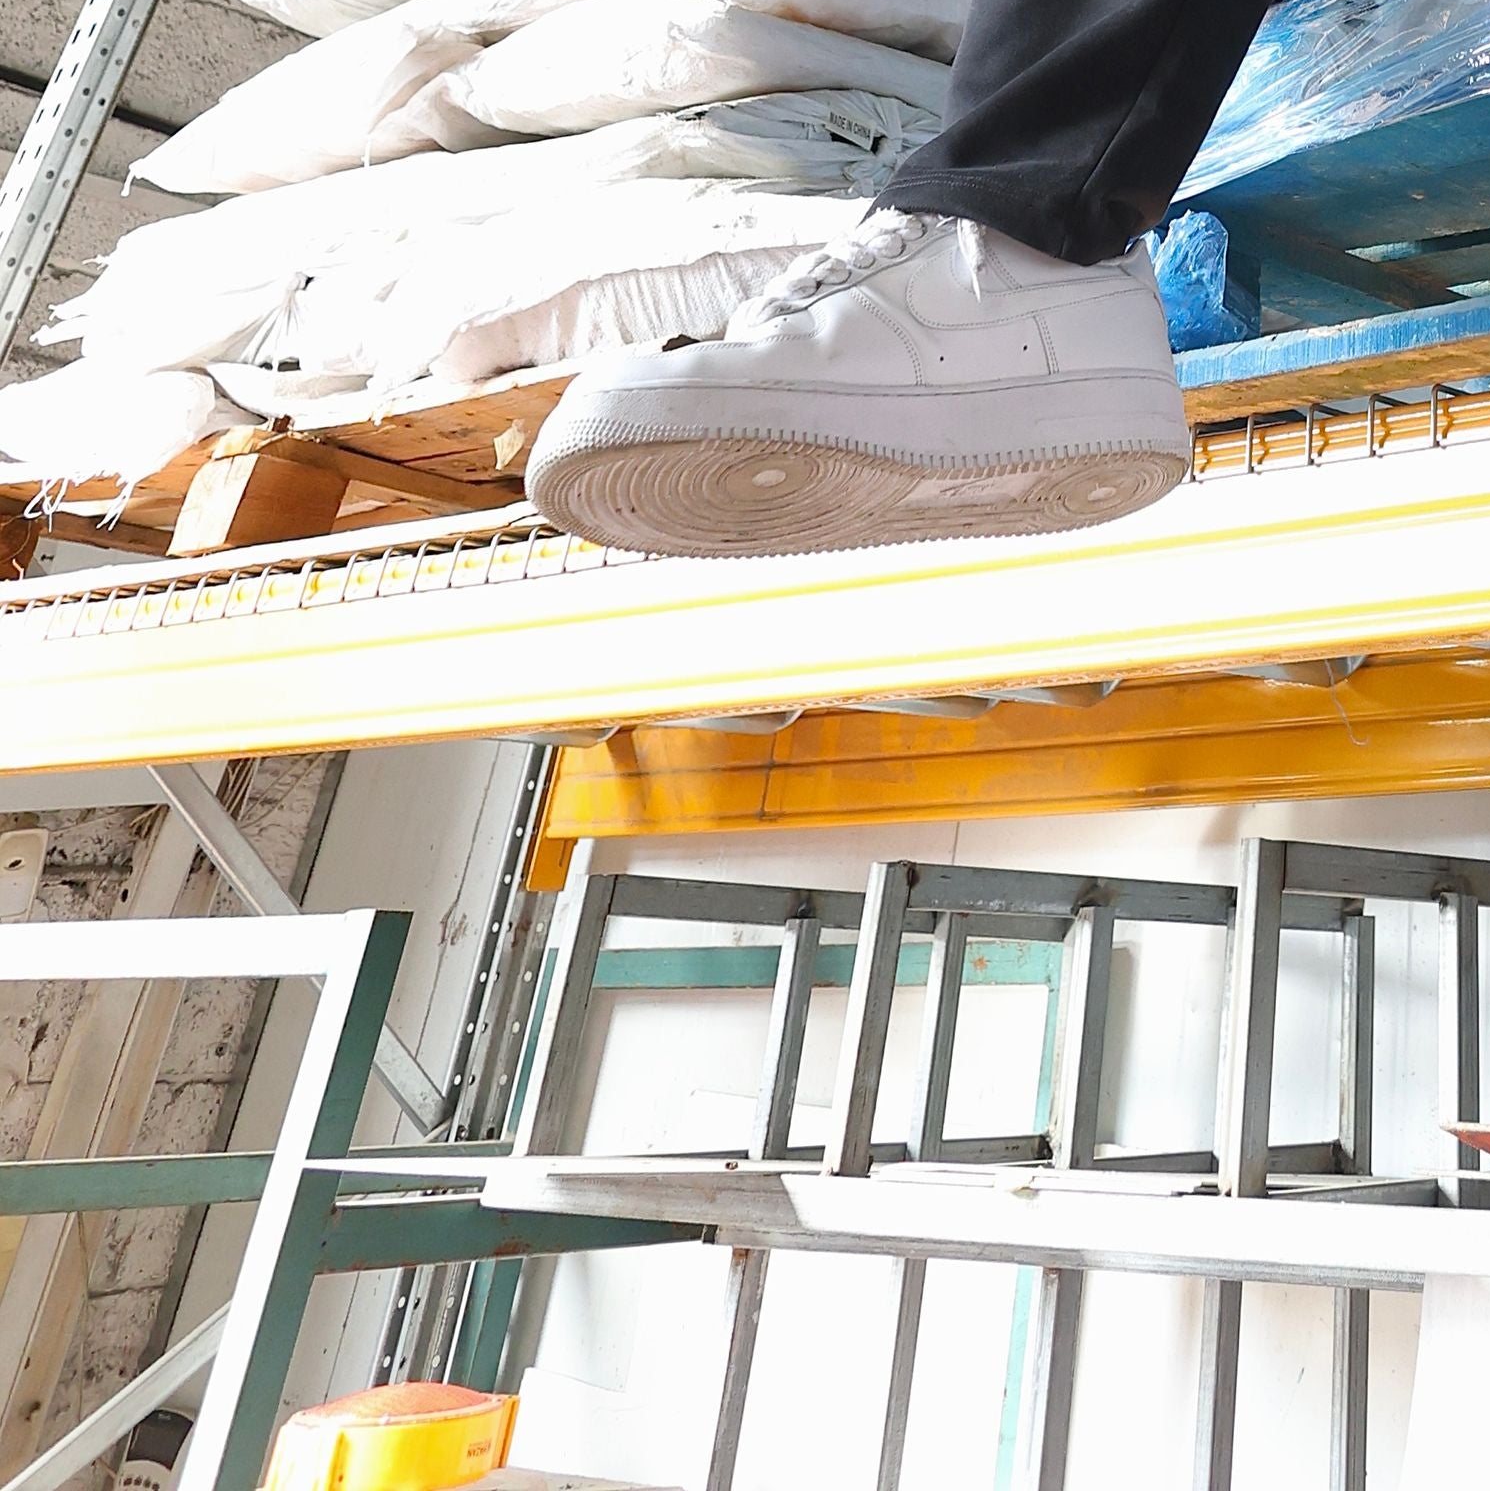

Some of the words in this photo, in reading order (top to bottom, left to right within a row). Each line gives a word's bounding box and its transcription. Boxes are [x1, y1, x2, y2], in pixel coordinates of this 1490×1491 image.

[830, 111, 846, 130] MADE
[846, 119, 853, 133] IN
[853, 122, 871, 140] CHINA
